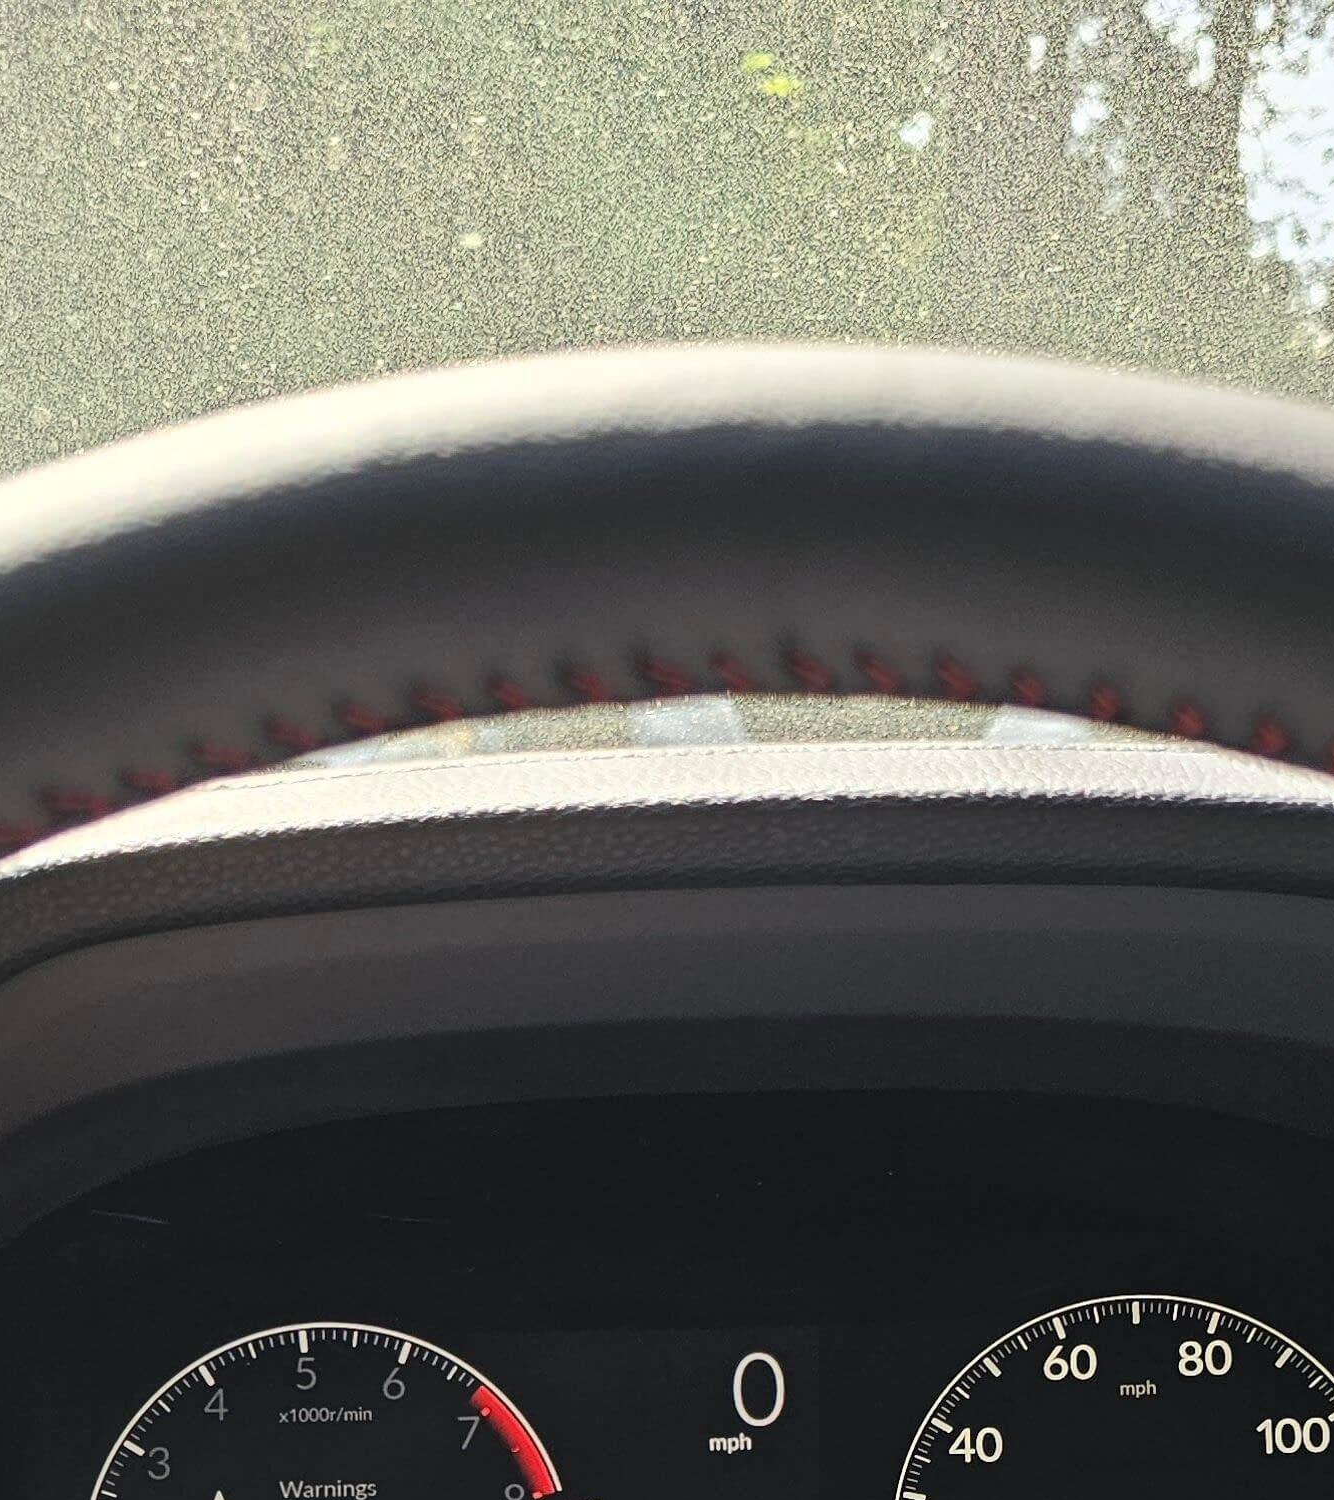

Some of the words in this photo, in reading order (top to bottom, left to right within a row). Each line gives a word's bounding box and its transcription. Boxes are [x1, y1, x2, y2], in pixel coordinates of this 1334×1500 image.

[296, 1356, 317, 1391] 5
[1042, 1343, 1098, 1381] 60
[1177, 1339, 1233, 1377] 80
[382, 1364, 407, 1401] 6
[732, 1351, 786, 1427] 0
[1119, 1379, 1158, 1399] mph
[203, 1387, 229, 1421] 4
[278, 1405, 373, 1424] x1000r/min
[457, 1415, 480, 1450] 7
[708, 1432, 753, 1455] mph
[948, 1427, 1003, 1464] 40
[1255, 1416, 1331, 1455] 100
[148, 1446, 171, 1481] 3
[279, 1478, 378, 1500] Warnings
